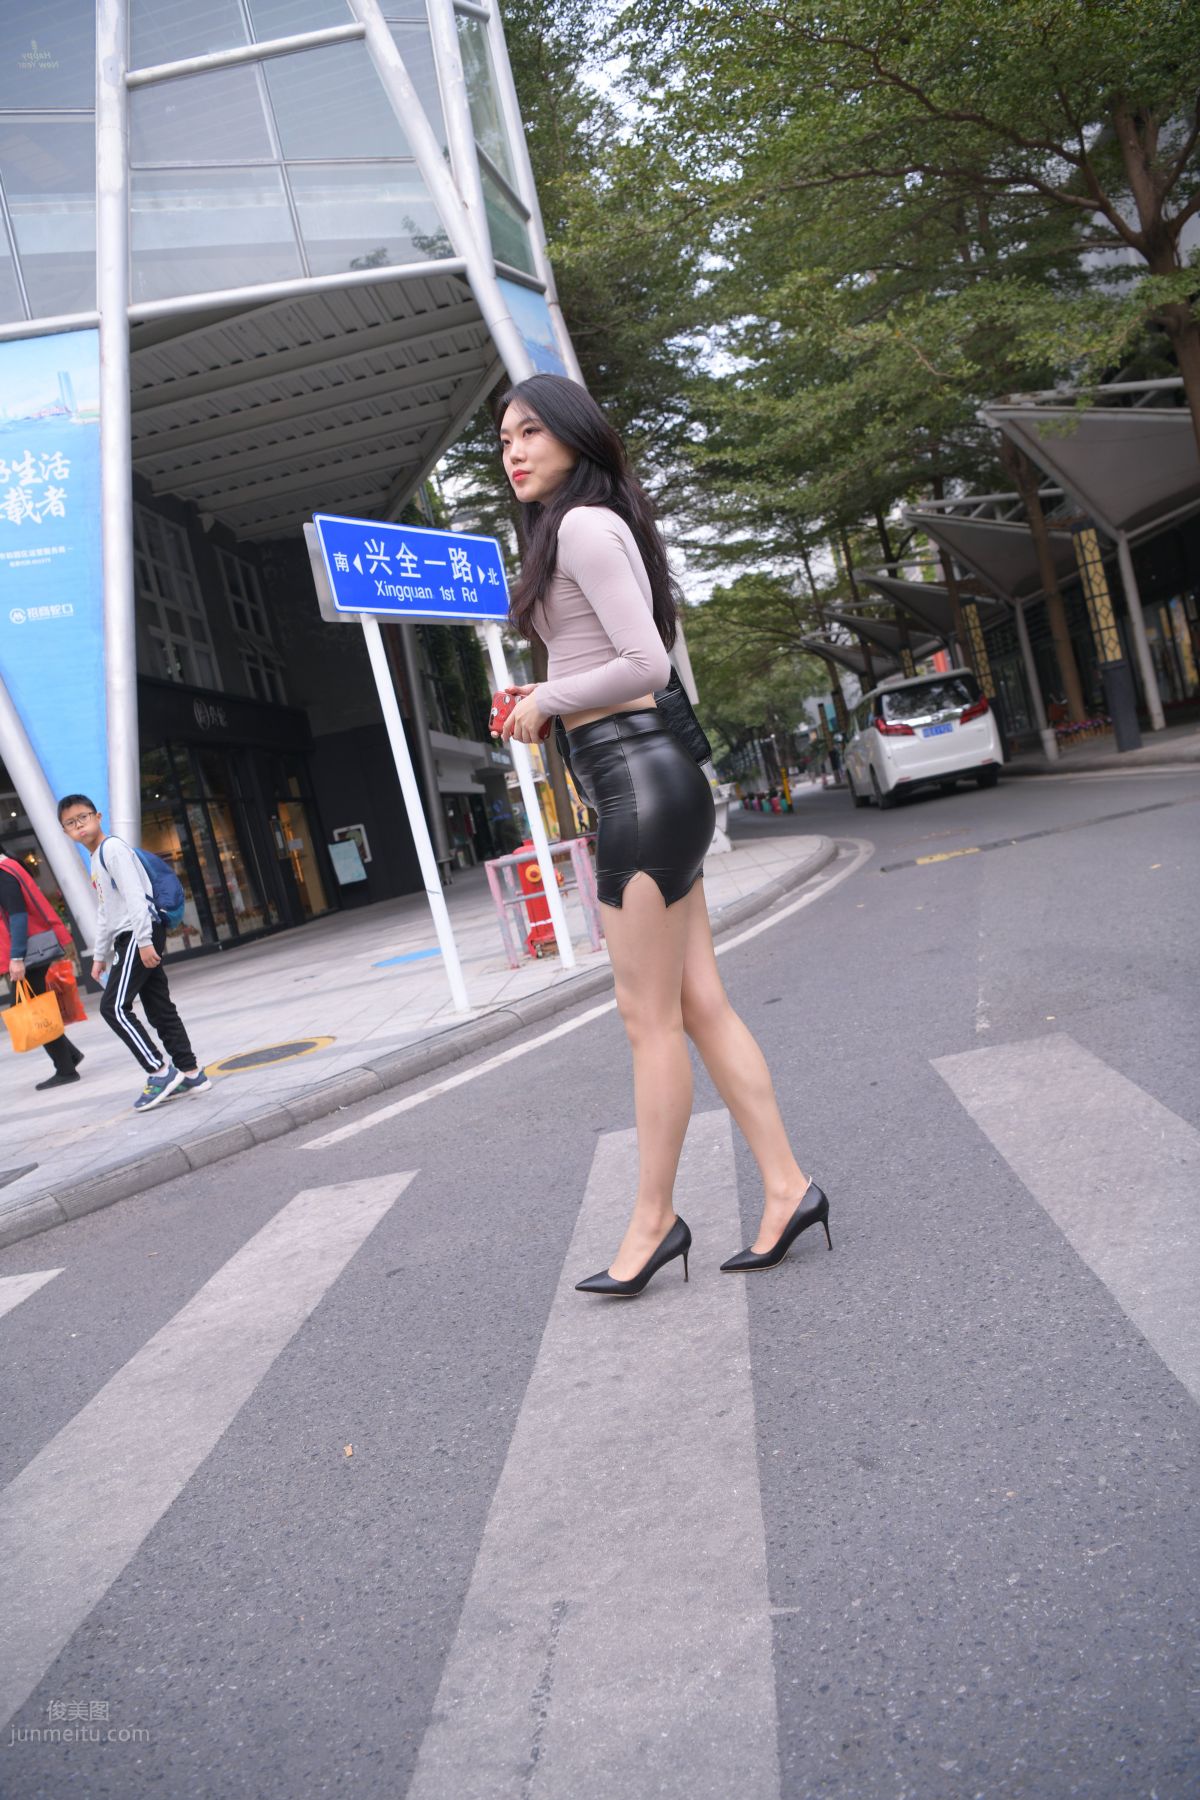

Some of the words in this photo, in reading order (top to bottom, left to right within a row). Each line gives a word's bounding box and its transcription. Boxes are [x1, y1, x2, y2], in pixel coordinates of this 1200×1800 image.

[333, 552, 350, 573] 南
[364, 538, 474, 583] 兴全一路
[488, 567, 500, 586] 北
[374, 579, 433, 602] Xingquan
[439, 586, 456, 601] 1st
[462, 586, 478, 603] Rd
